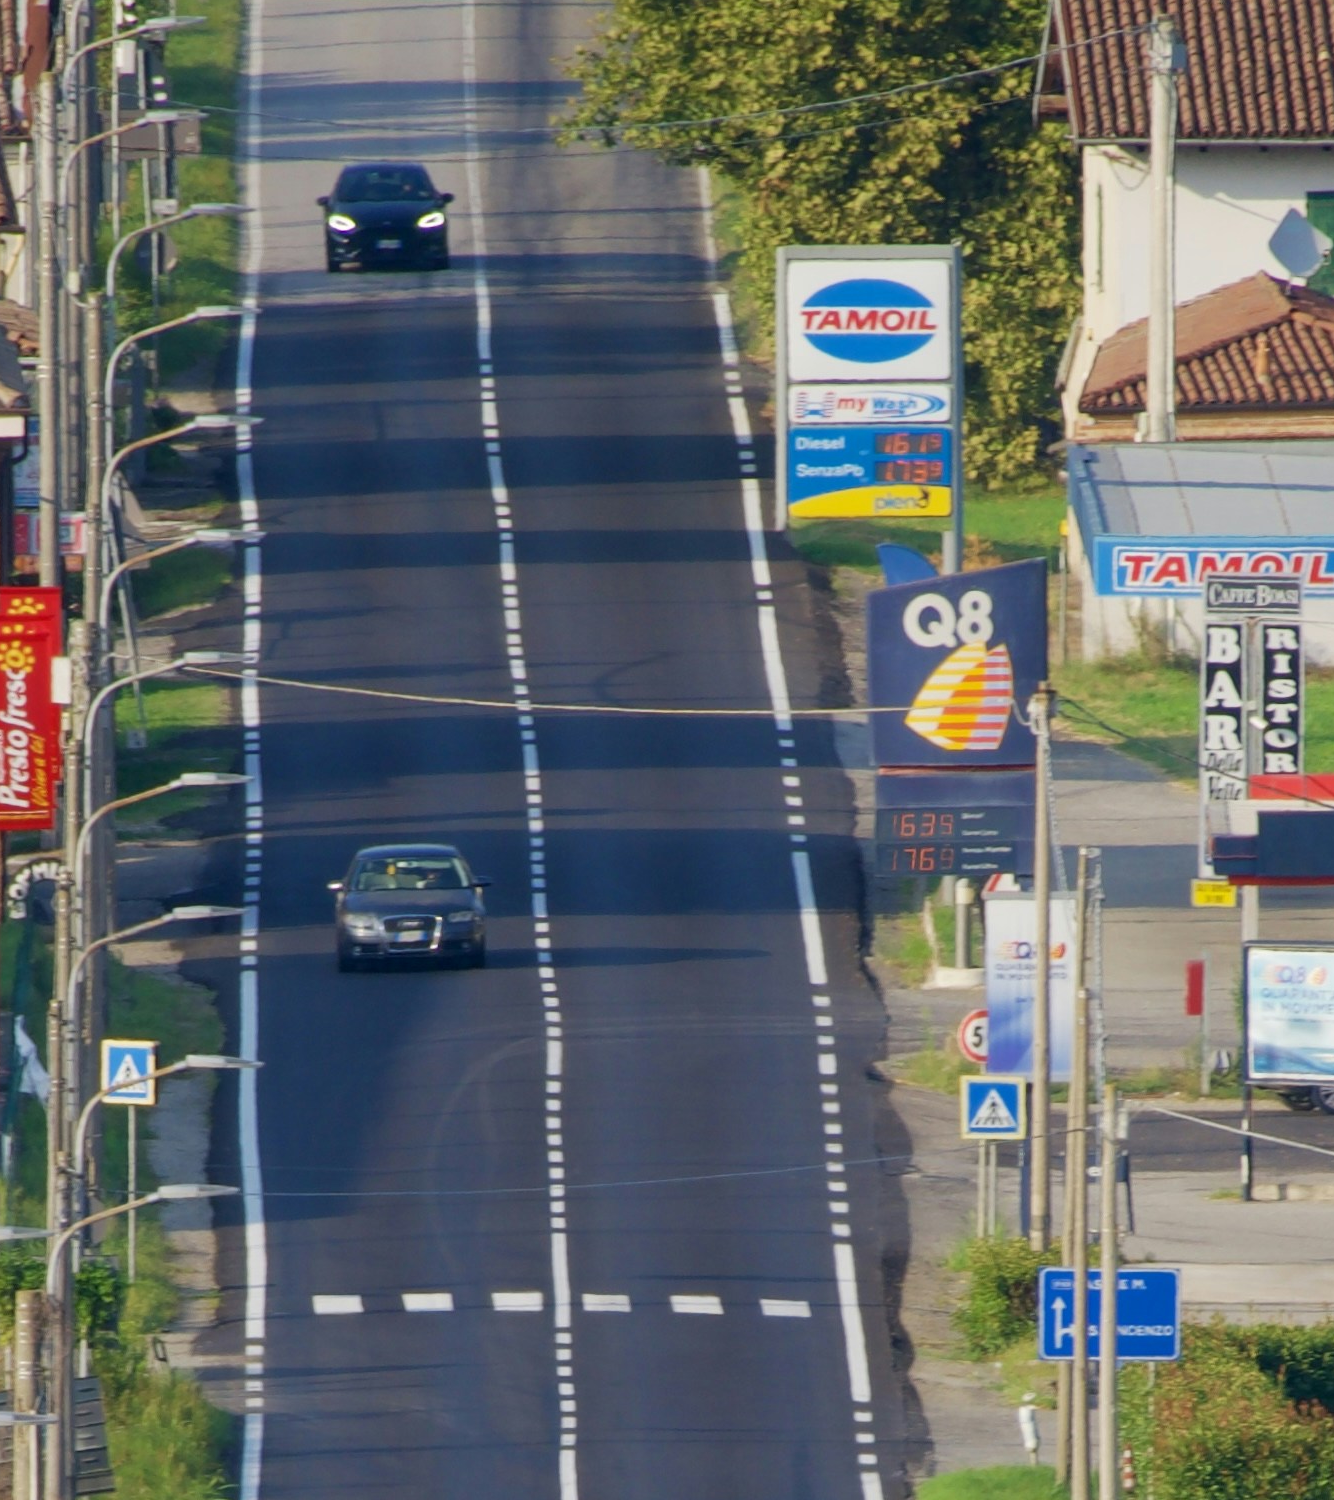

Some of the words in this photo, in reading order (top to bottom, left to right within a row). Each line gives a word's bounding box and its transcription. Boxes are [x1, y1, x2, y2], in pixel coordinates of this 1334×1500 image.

[800, 309, 938, 332] TAMOIL
[837, 397, 867, 412] my
[872, 396, 917, 409] Wash
[794, 436, 846, 450] Diesel
[795, 463, 865, 478] SenzaPb
[903, 590, 994, 648] Q8
[1206, 627, 1243, 751] BAR
[891, 813, 954, 838] 1639
[1279, 965, 1306, 985] Q8
